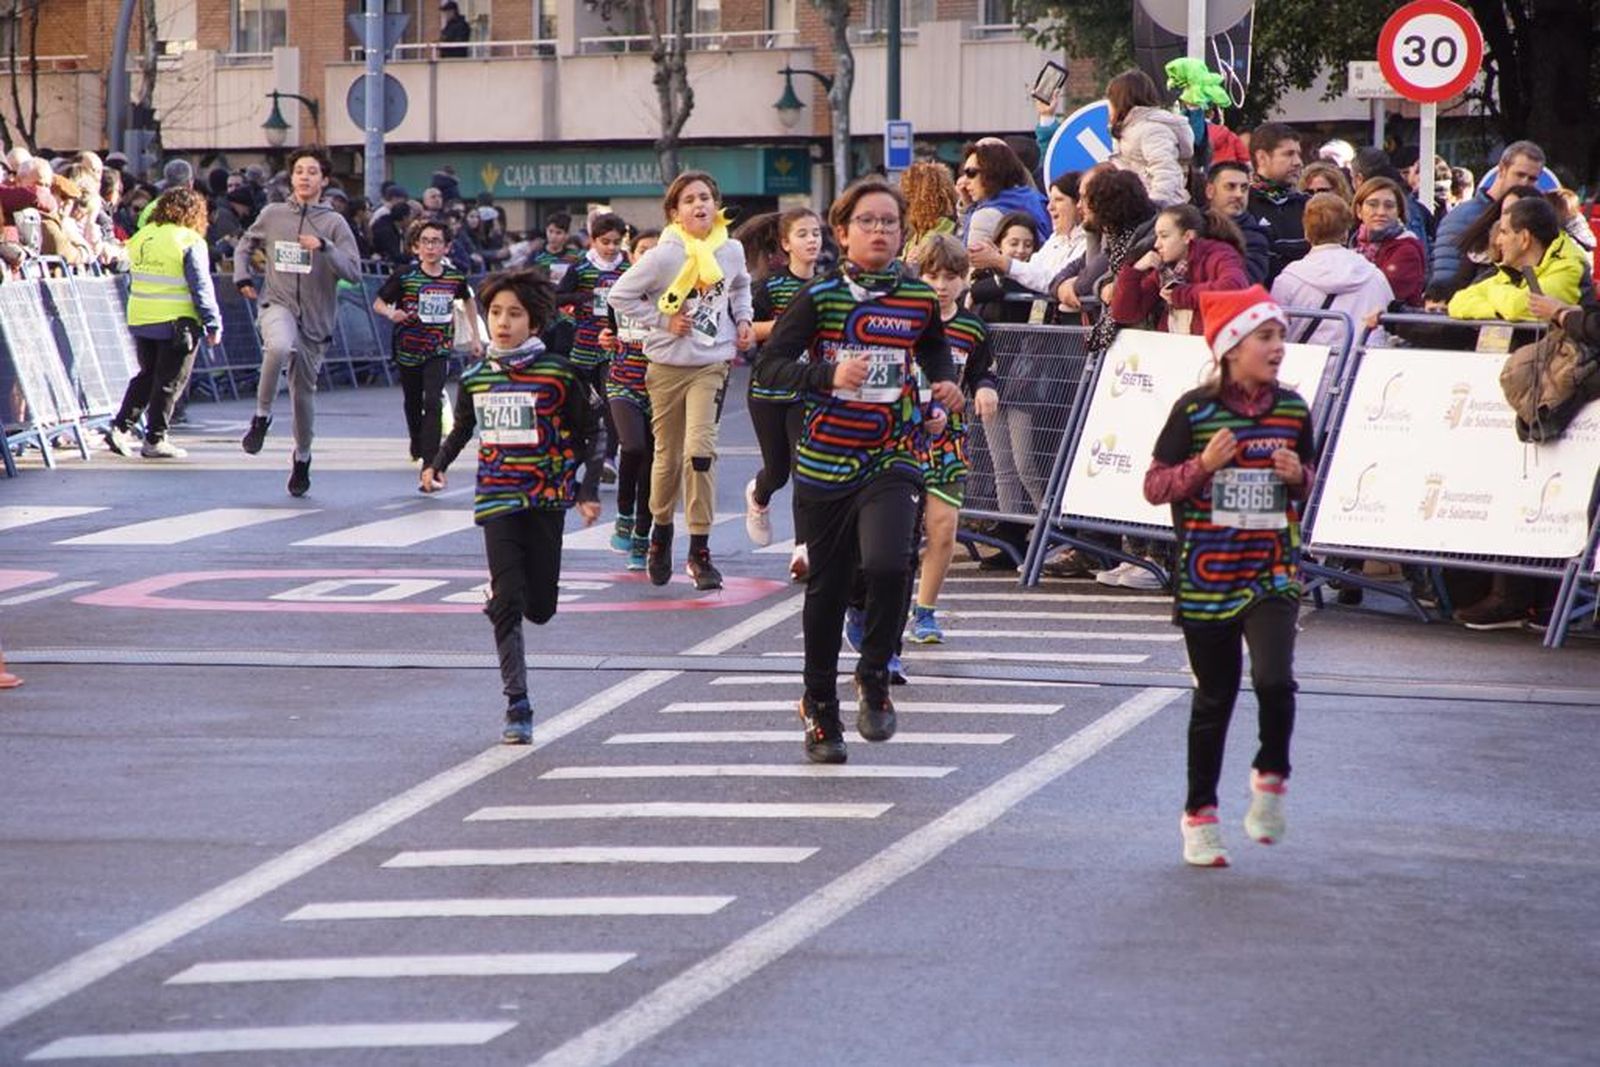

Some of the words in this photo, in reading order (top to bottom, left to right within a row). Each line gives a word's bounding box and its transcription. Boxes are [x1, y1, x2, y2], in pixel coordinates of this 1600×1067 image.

[1402, 35, 1458, 68] 30
[503, 164, 536, 191] CAJA
[539, 164, 583, 187] RURAL
[585, 163, 603, 186] DE
[605, 162, 692, 185] SALAMA
[865, 363, 889, 386] 23
[1121, 372, 1154, 388] SETEL
[484, 405, 521, 428] 5740
[1096, 452, 1132, 468] SETEL
[1223, 484, 1274, 509] 5866
